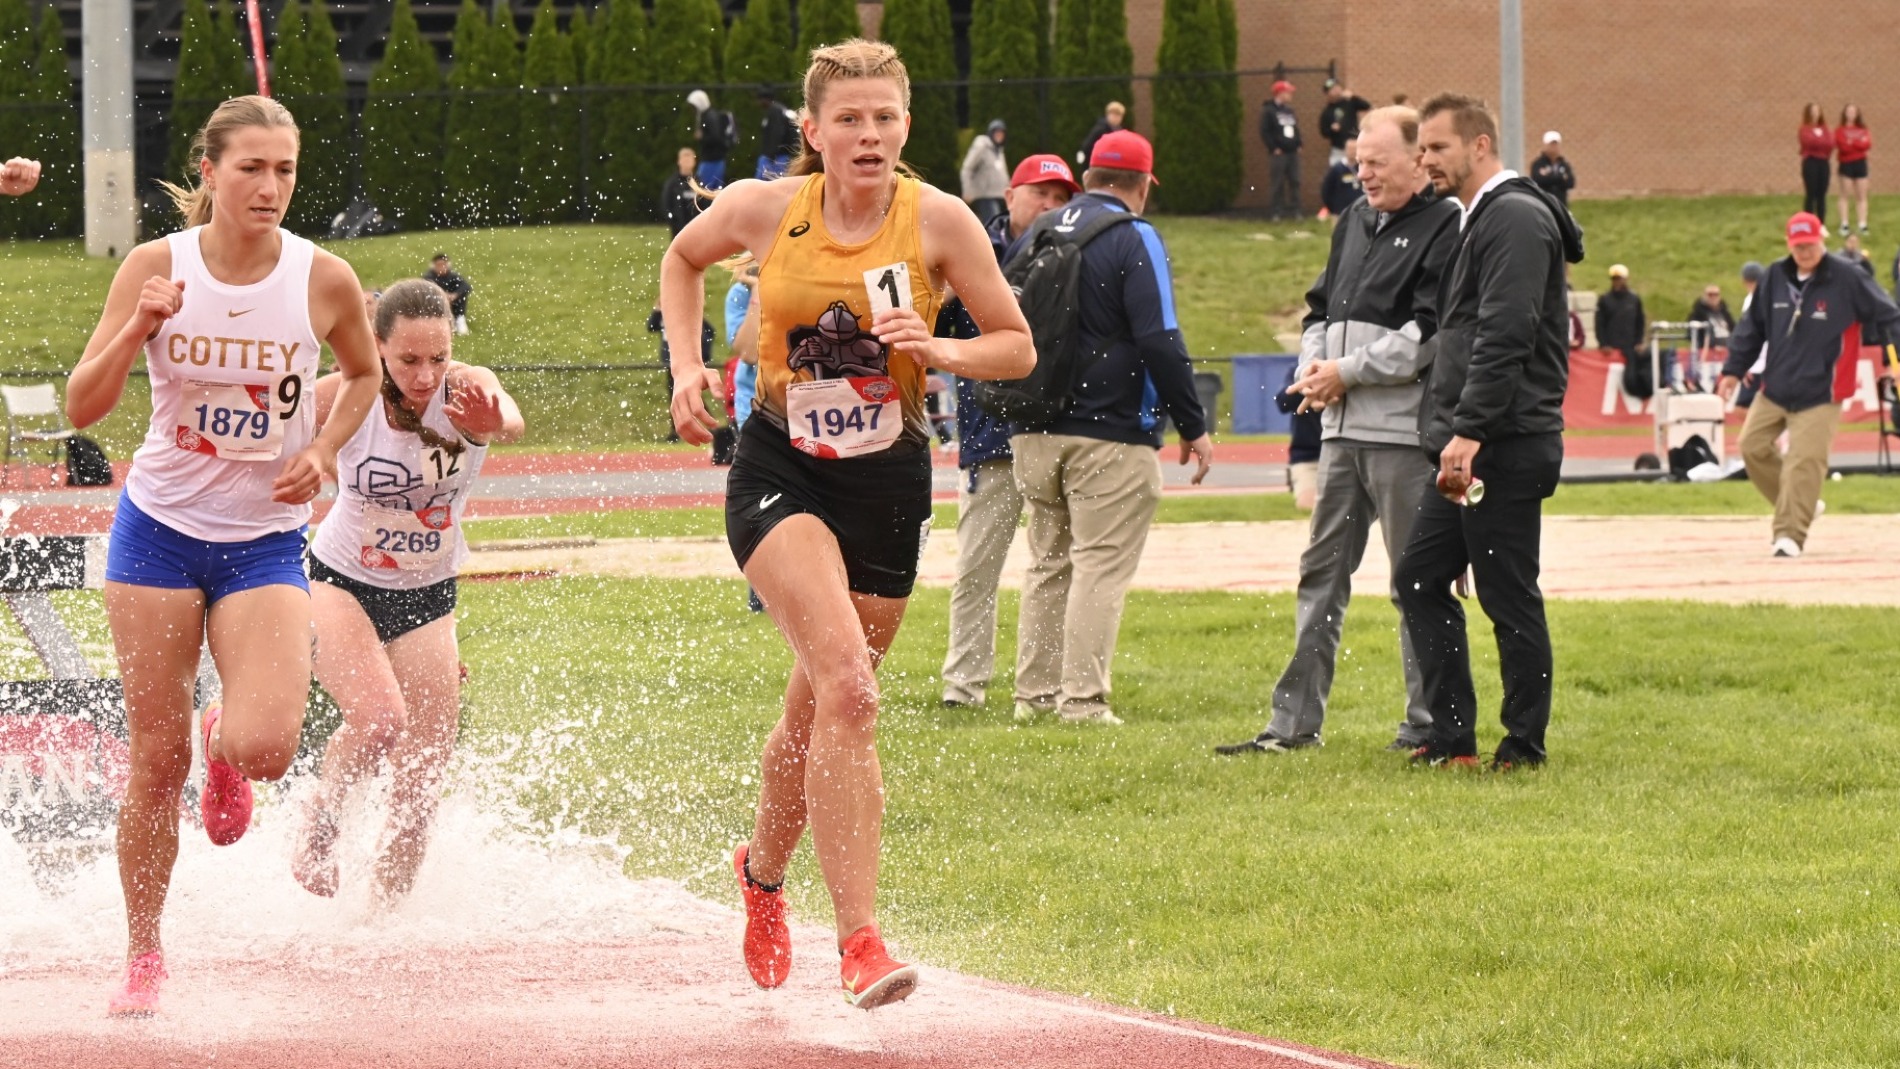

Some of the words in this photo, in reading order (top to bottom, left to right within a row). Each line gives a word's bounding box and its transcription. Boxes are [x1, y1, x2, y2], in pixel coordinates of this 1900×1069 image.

[877, 269, 900, 308] 1
[168, 333, 300, 373] COTTEY
[278, 374, 302, 420] 9
[195, 403, 270, 440] 1879
[805, 403, 883, 438] 1947
[429, 449, 460, 480] 12
[375, 528, 441, 554] 2269
